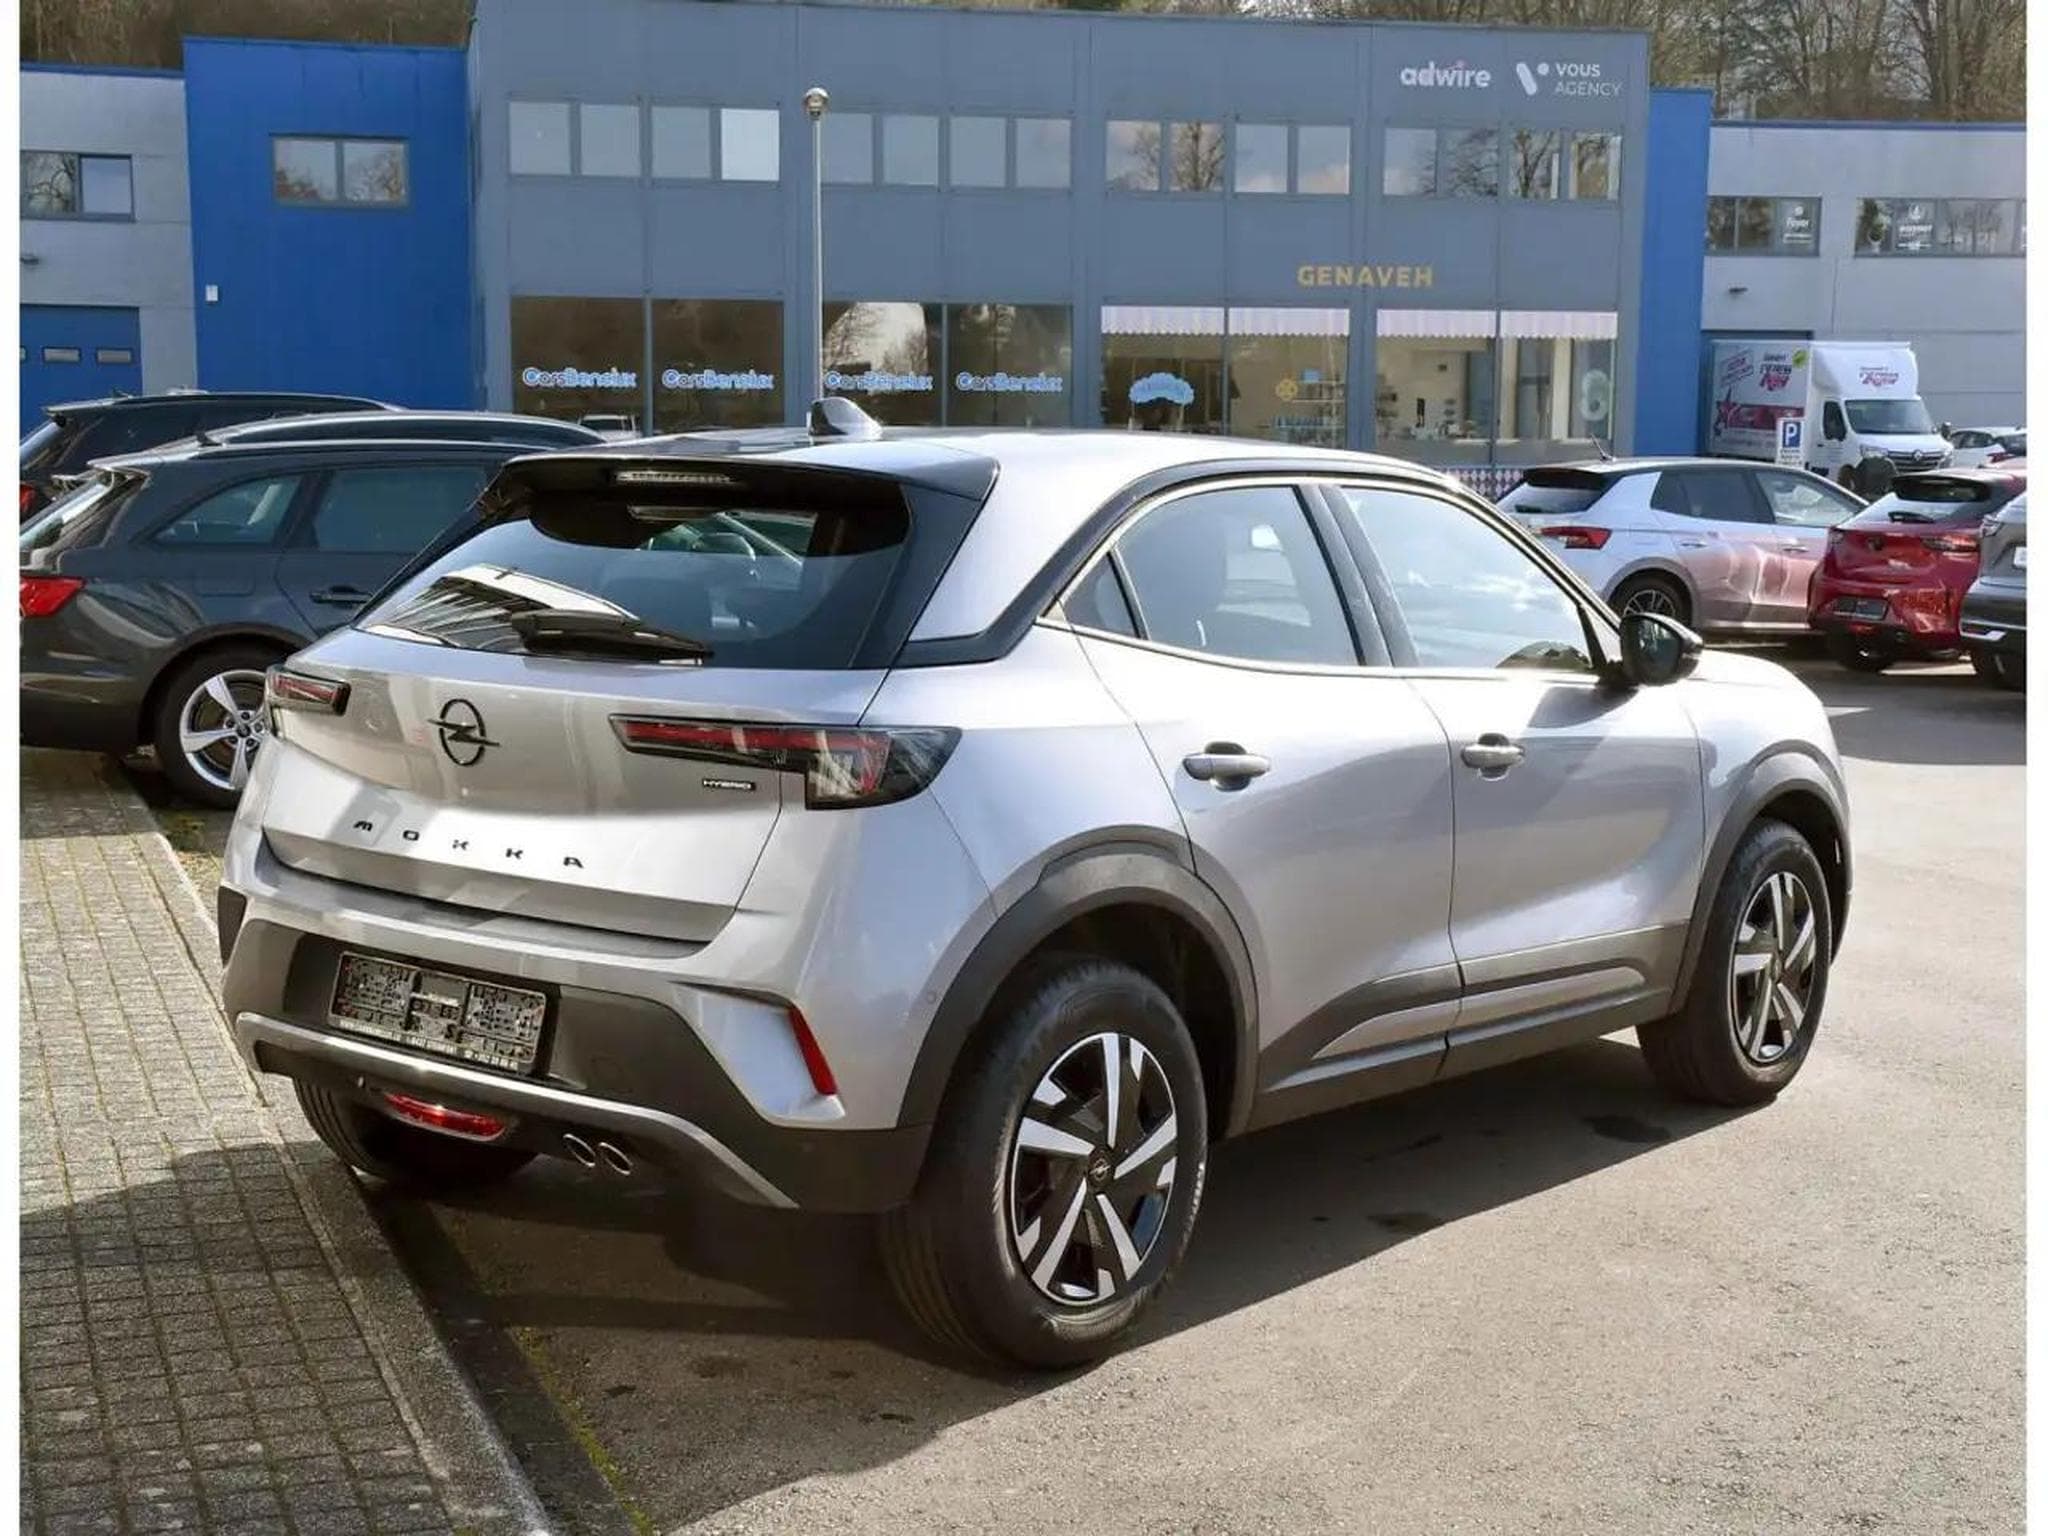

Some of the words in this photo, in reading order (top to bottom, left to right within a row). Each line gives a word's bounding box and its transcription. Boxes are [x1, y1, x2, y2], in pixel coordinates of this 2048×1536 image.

[1400, 60, 1491, 88] adwire
[1555, 63, 1601, 78] VOUS
[1555, 81, 1622, 97] AGENCY
[1297, 265, 1433, 288] GENAVEH
[522, 367, 637, 388] CarsBenelux
[1785, 422, 1798, 446] P
[353, 819, 585, 869] MOKKA
